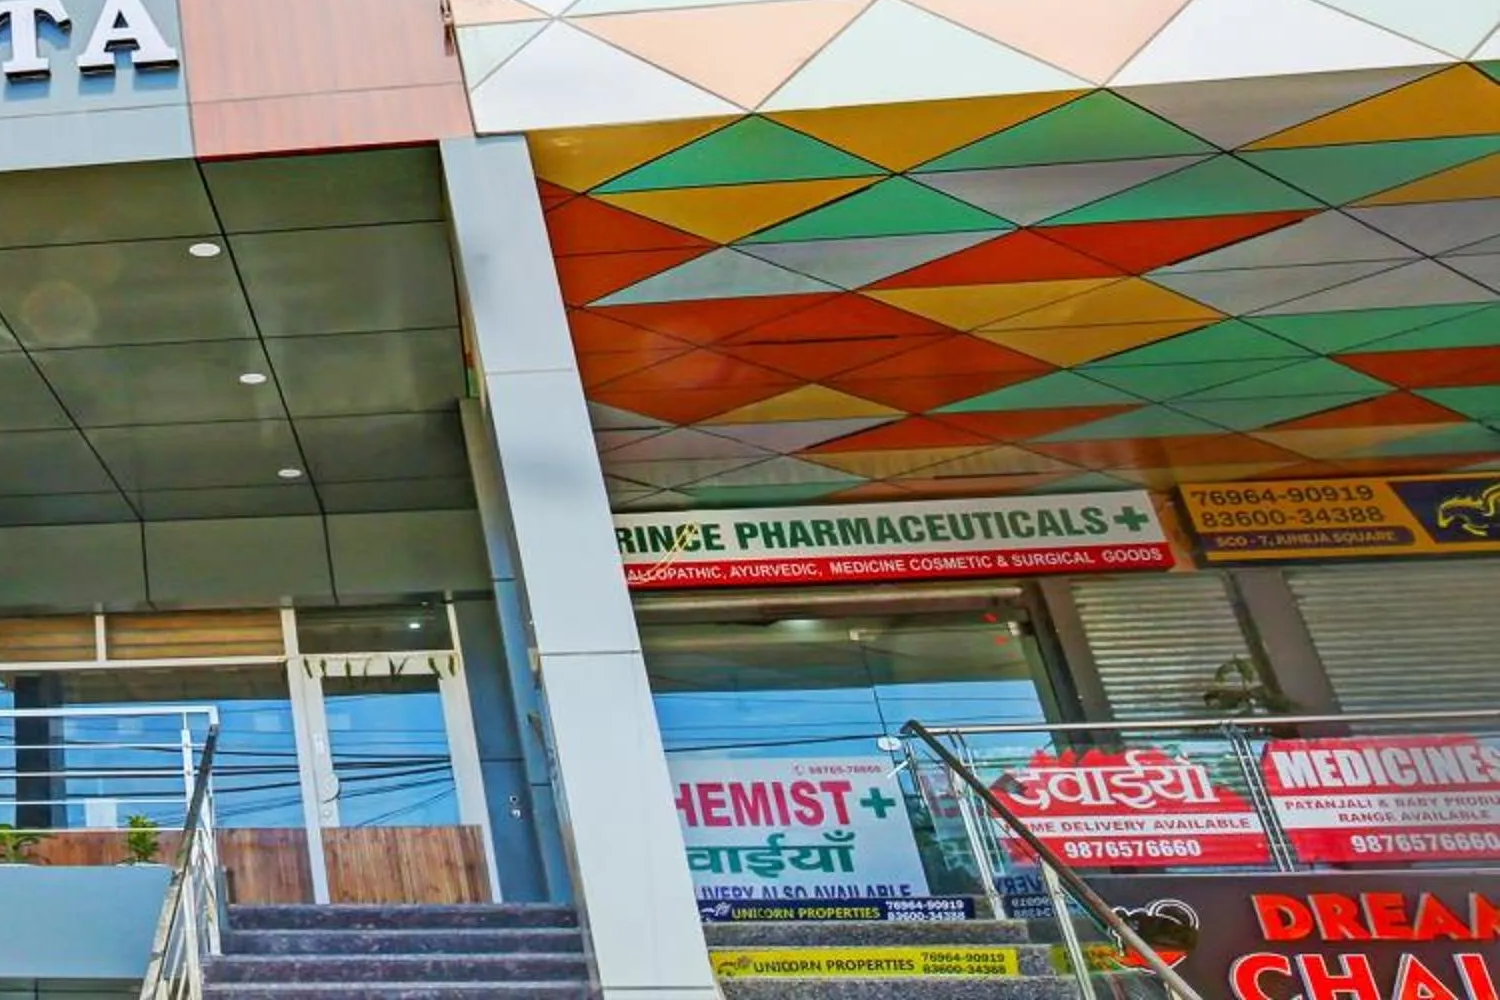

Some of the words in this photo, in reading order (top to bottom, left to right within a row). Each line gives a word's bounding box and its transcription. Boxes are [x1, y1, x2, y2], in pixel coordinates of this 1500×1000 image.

[1190, 484, 1375, 508] 76964-90919
[1201, 505, 1386, 528] 83600-34388
[734, 506, 1109, 550] PHARMACEUTICALS
[830, 558, 906, 574] MEDICINE
[909, 556, 994, 572] COSMETIC
[997, 554, 1009, 568] &
[1011, 551, 1096, 568] SURGICAL
[1102, 547, 1163, 563] GOODS
[1284, 799, 1374, 811] PATANJALI
[1061, 820, 1148, 832] DELIVERY
[1153, 817, 1251, 830] AVAILABLE
[1400, 809, 1493, 822] AVAILABLE
[1064, 839, 1202, 859] 9876576660
[1350, 833, 1500, 854] 9876576660
[732, 906, 795, 920] UNICORN
[797, 905, 881, 920] PROPERTIES
[753, 959, 824, 974] UNICORN
[826, 957, 915, 973] PROPERTIES
